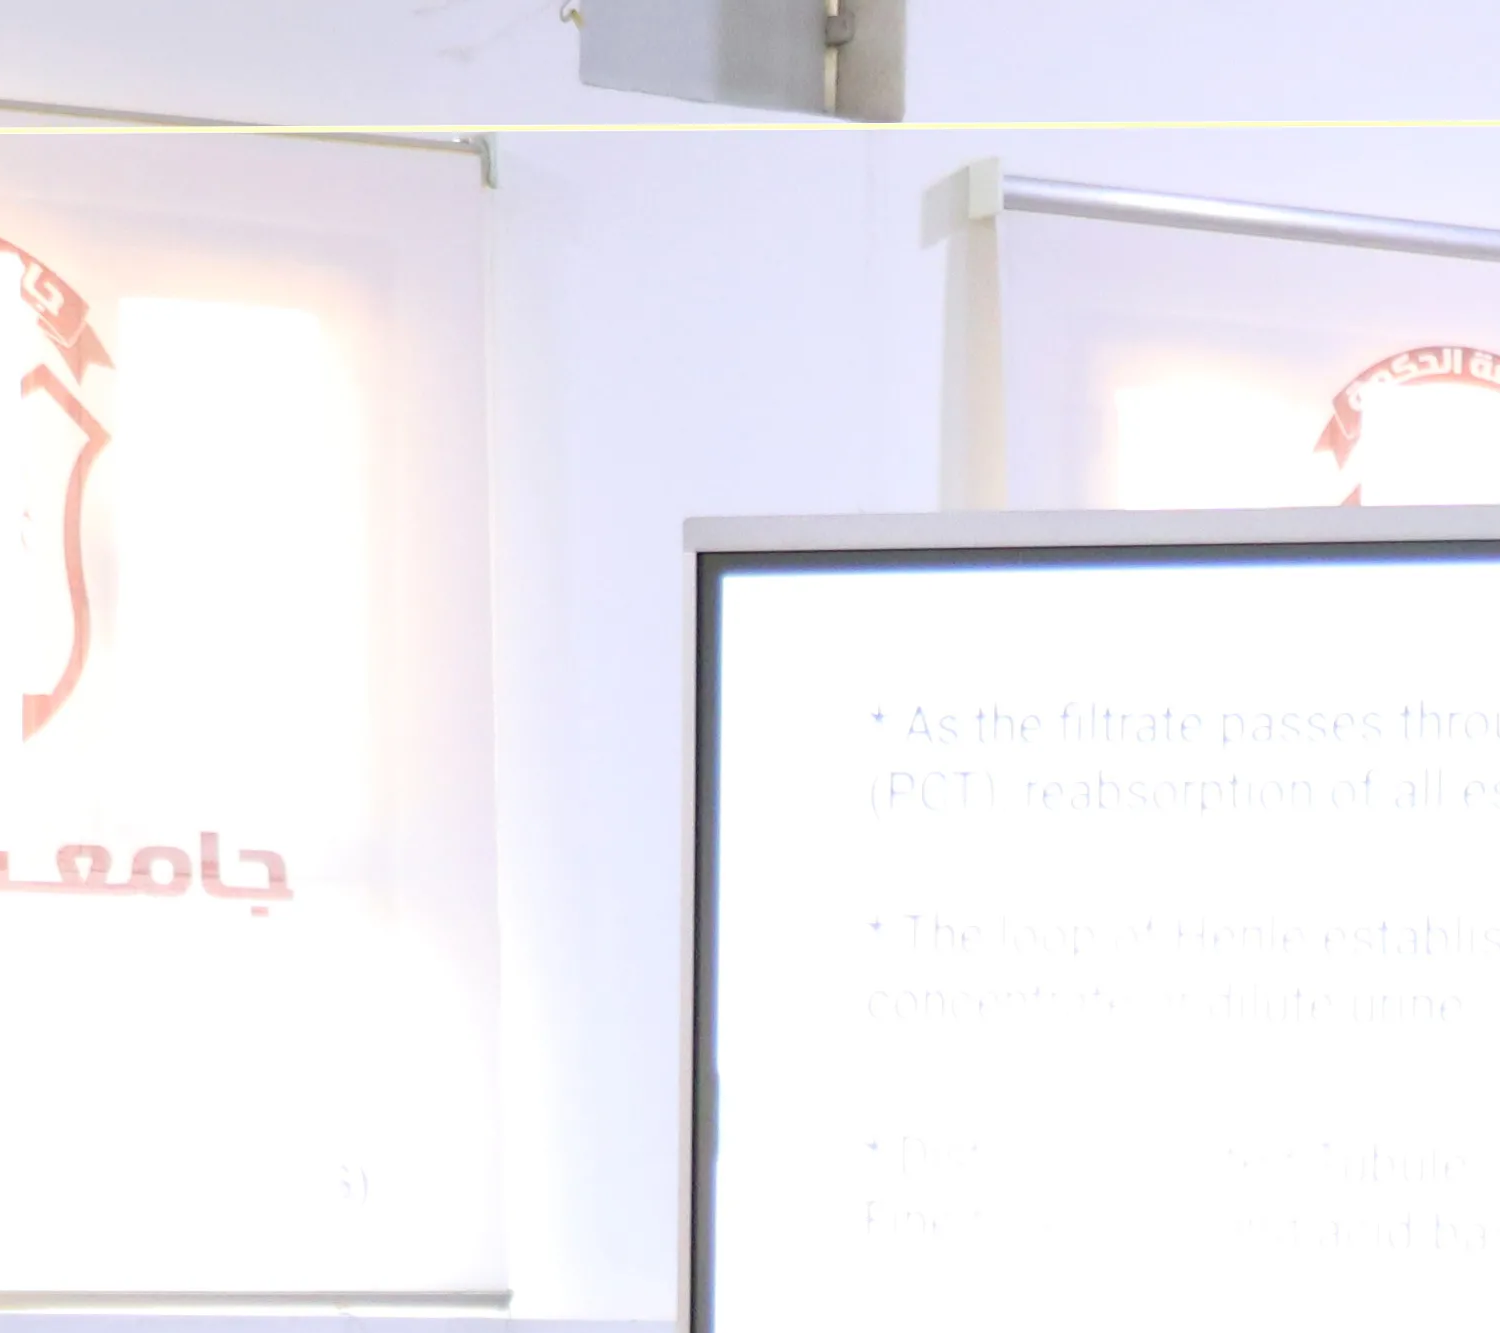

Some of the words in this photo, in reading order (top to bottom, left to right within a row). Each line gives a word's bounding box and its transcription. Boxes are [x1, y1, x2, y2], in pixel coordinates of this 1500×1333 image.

[905, 704, 960, 746] As
[973, 702, 1042, 746] the
[1057, 701, 1203, 747] filtrate
[1221, 709, 1384, 748] passes
[1024, 768, 1315, 816] reabsorption
[1330, 767, 1381, 812] of
[1392, 768, 1445, 812] all
